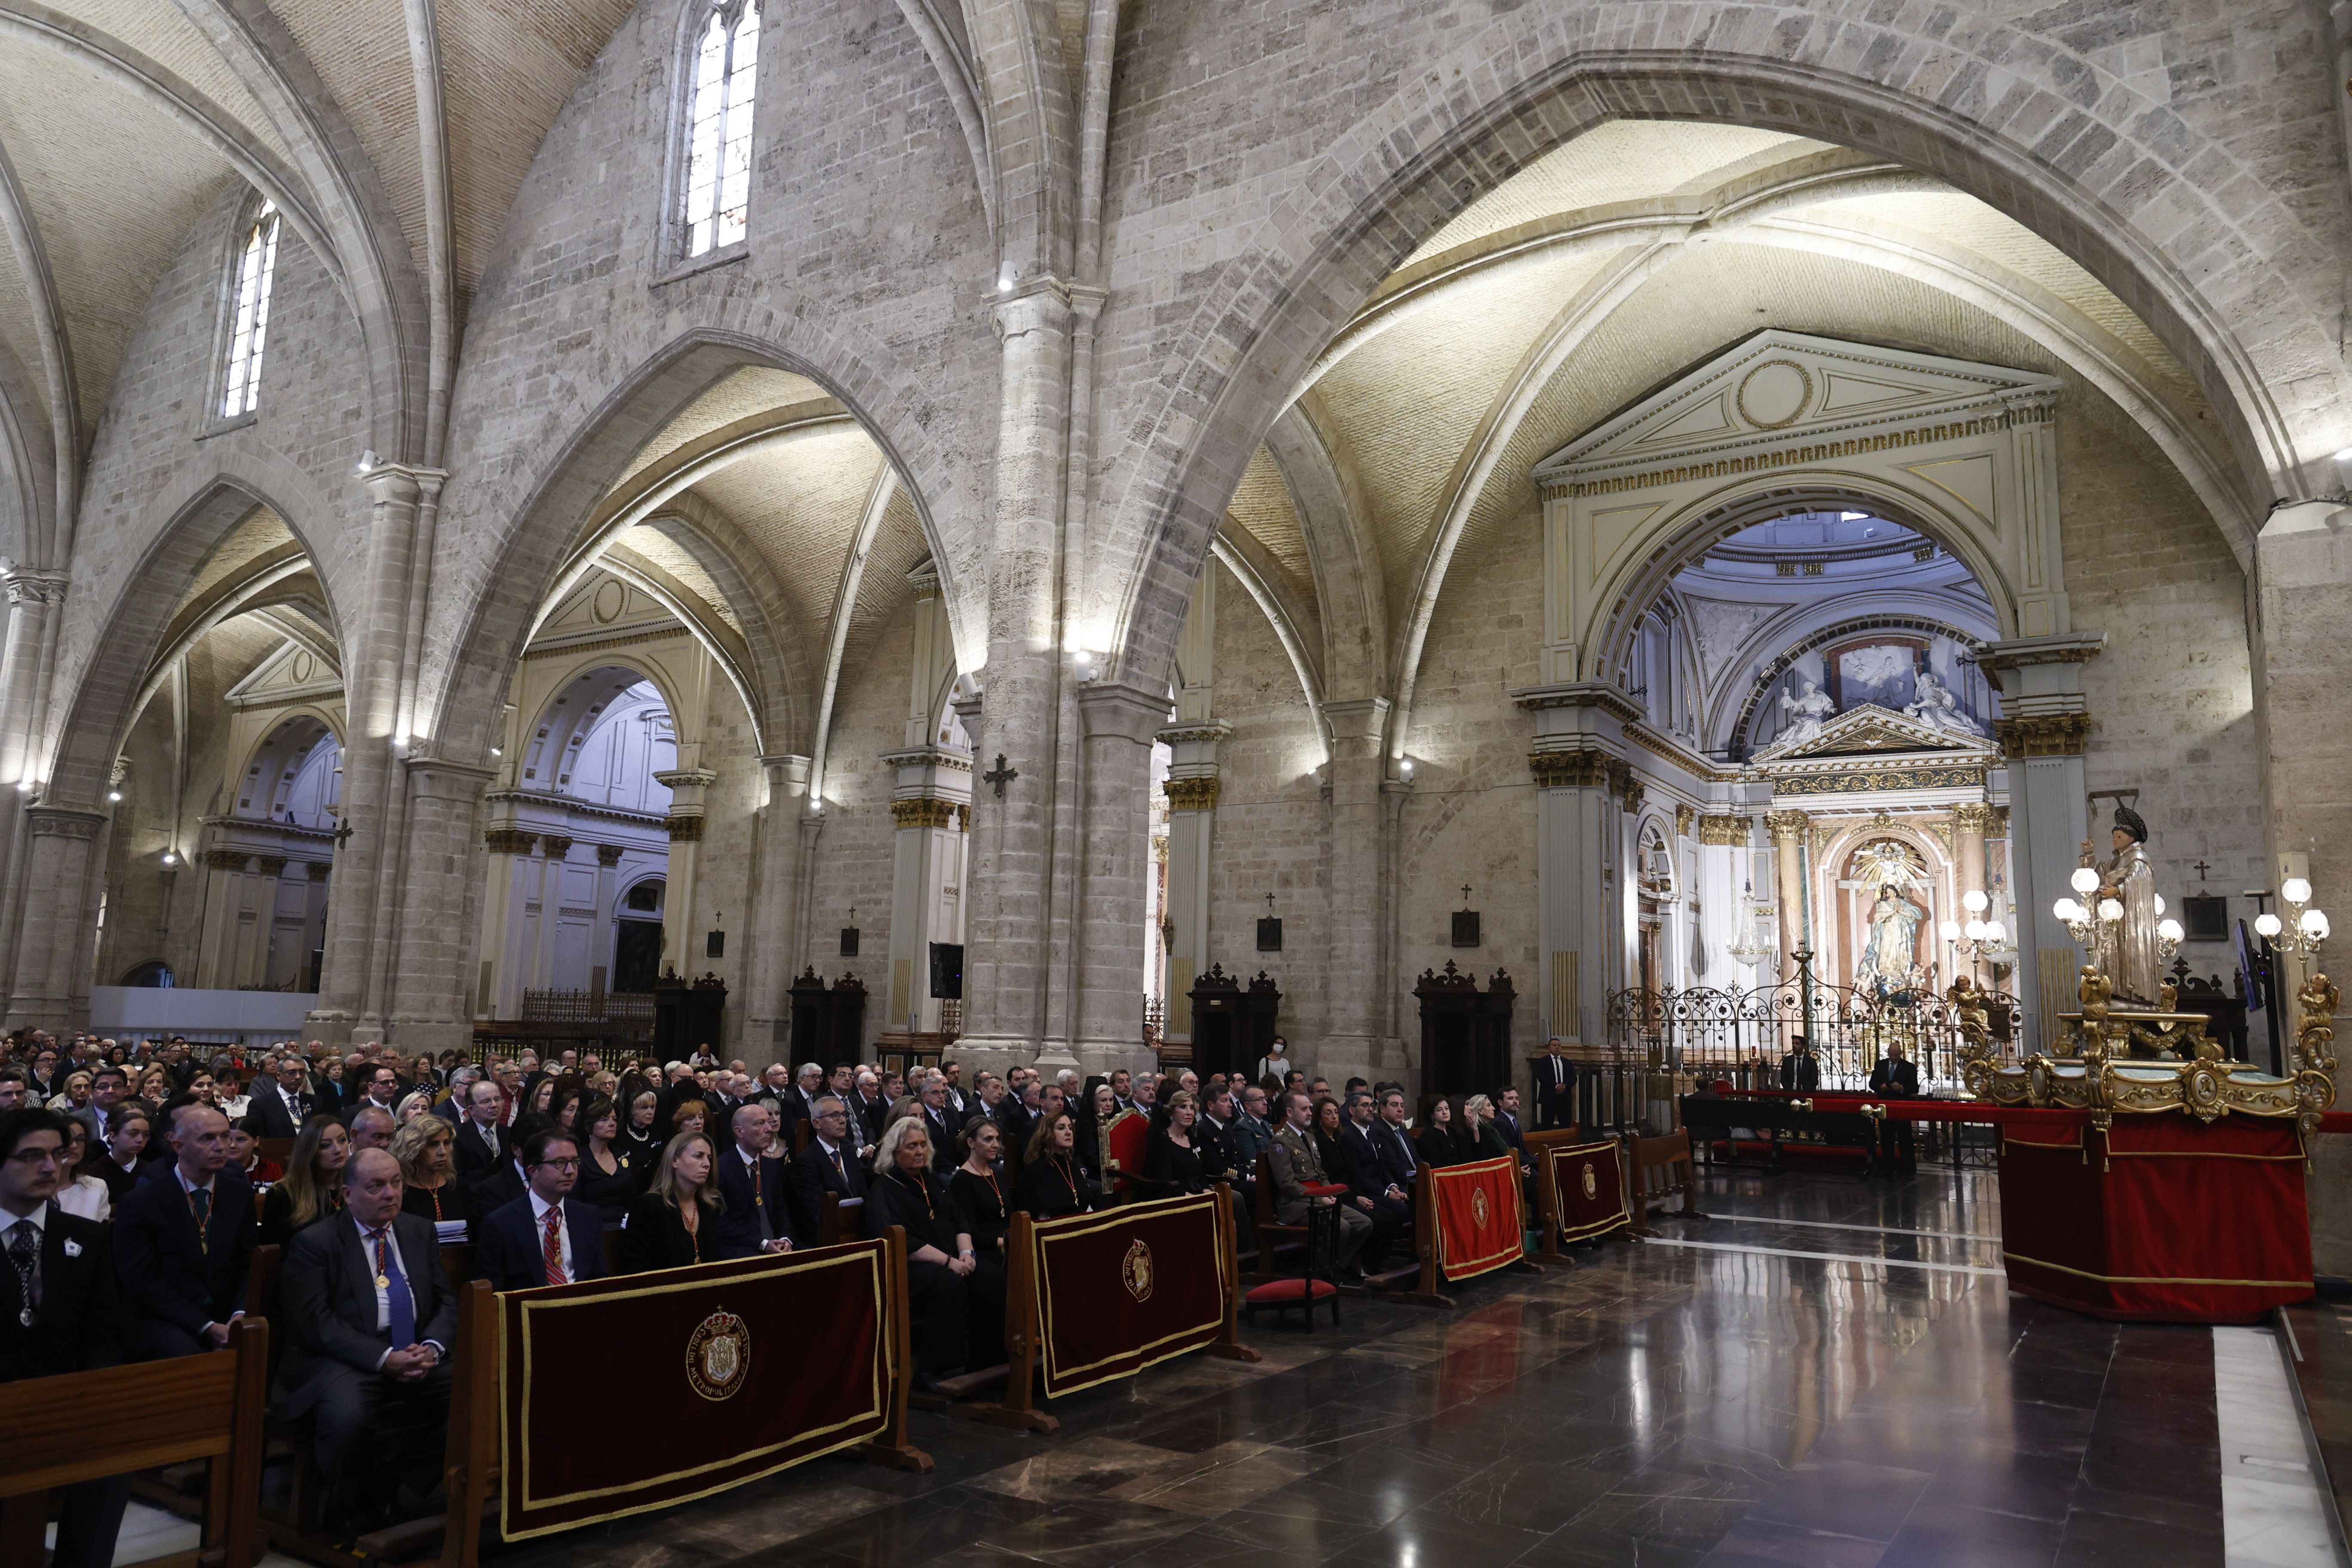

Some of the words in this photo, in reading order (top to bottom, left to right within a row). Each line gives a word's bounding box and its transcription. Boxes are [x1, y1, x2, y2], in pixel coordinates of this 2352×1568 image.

[689, 1329, 706, 1363] CABILDO
[735, 1320, 748, 1357] VALENCIA
[689, 1367, 741, 1396] METROPOLITANO
